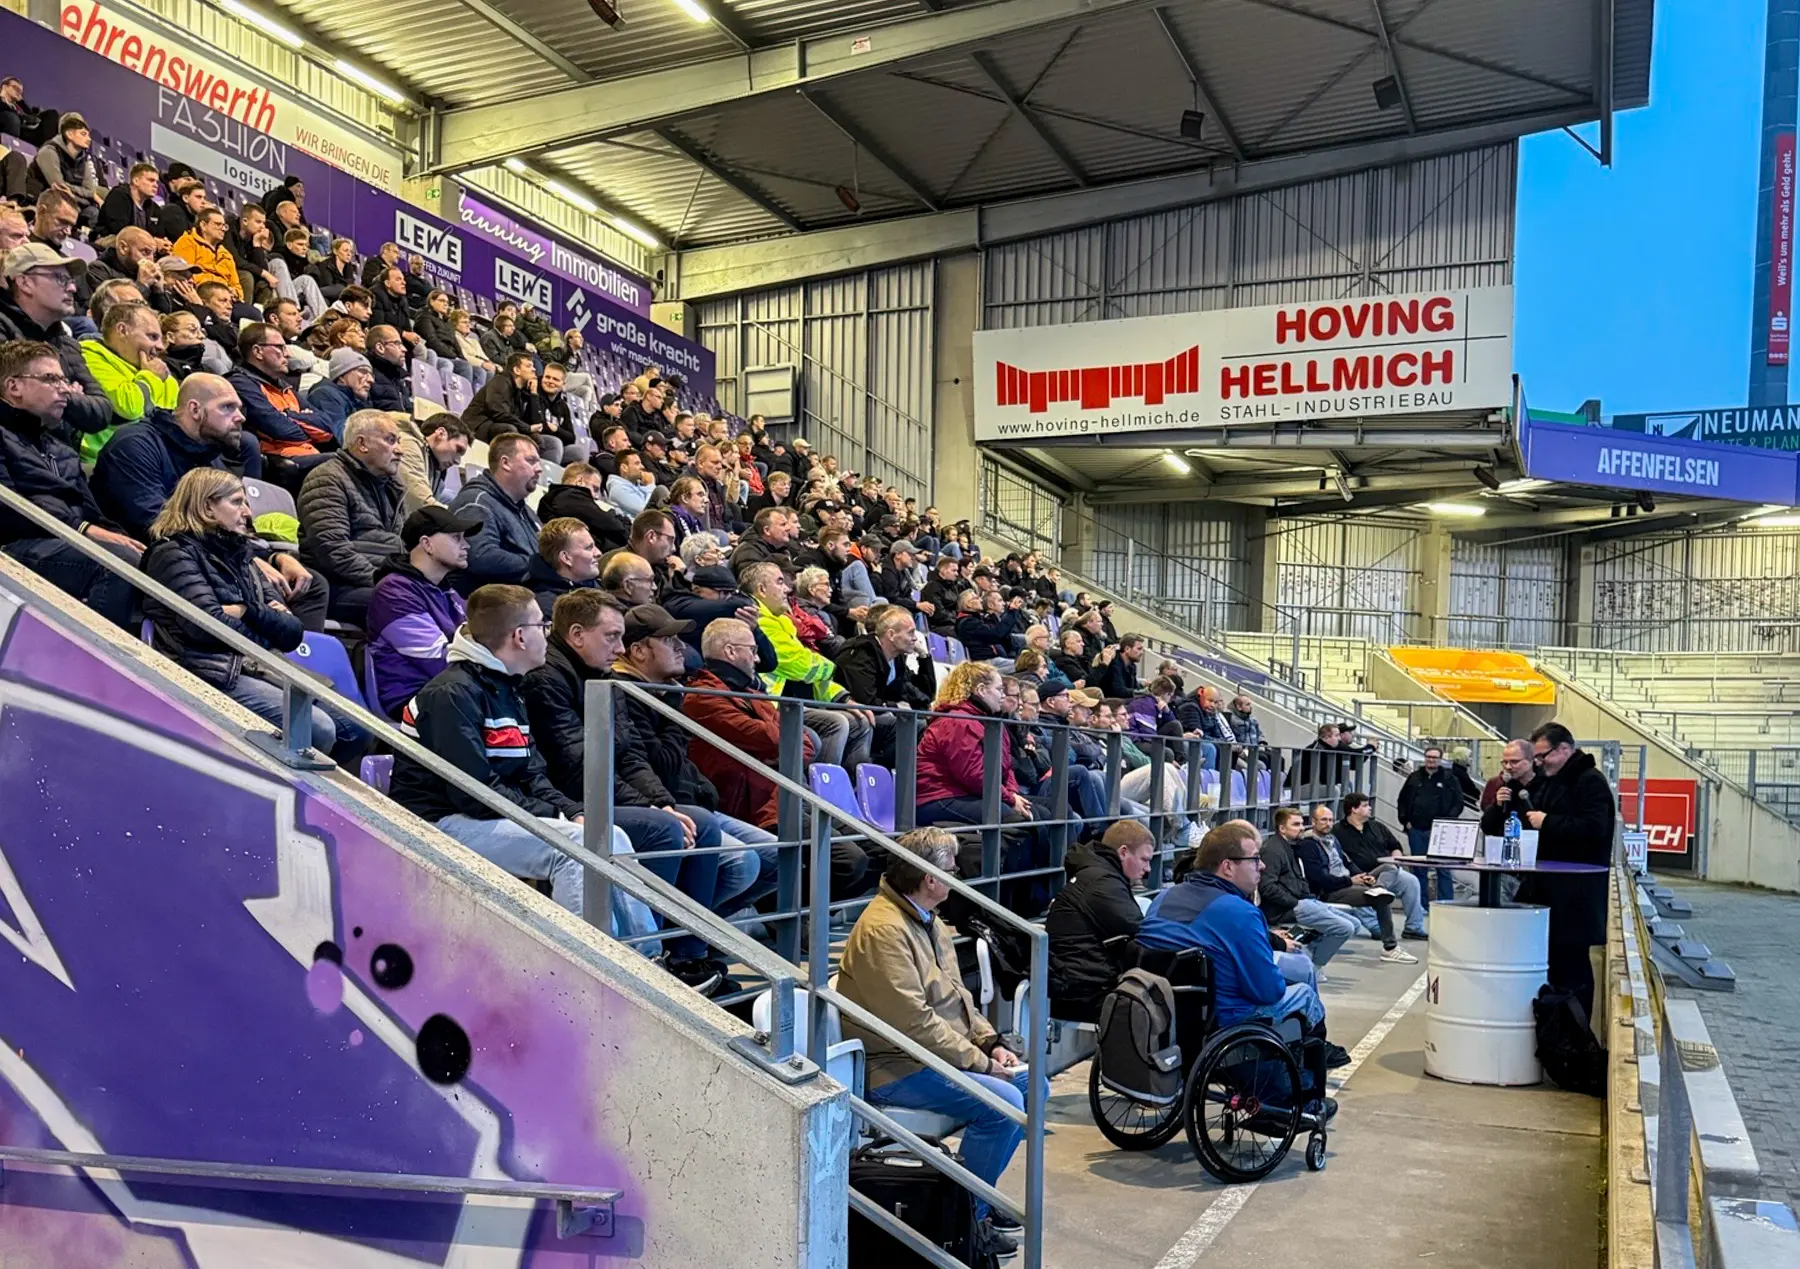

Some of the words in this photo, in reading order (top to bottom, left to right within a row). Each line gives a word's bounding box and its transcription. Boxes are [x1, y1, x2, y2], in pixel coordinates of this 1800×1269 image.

[61, 3, 276, 135] ehrenswerth
[296, 126, 319, 151] WIR
[320, 139, 370, 175] BRINGEN
[371, 165, 390, 185] DIE
[224, 159, 277, 193] logisti
[1780, 176, 1791, 198] Geld
[1780, 199, 1790, 214] als
[400, 217, 458, 265] LEWE
[1780, 214, 1790, 240] mehr
[1780, 241, 1788, 257] um
[499, 264, 549, 307] LEWE
[551, 240, 639, 307] Immobilien
[1276, 297, 1454, 345] HOVING
[596, 312, 646, 348] große
[649, 332, 701, 372] kracht
[610, 341, 627, 355] wir
[1221, 349, 1454, 400] HELLMICH
[997, 409, 1200, 435] www.hoving-hellmich.de
[1220, 391, 1453, 420] STAHL-INDUSTRIEBAU
[1704, 407, 1800, 435] NEUMAN
[1597, 447, 1720, 487] AFFENFELSEN
